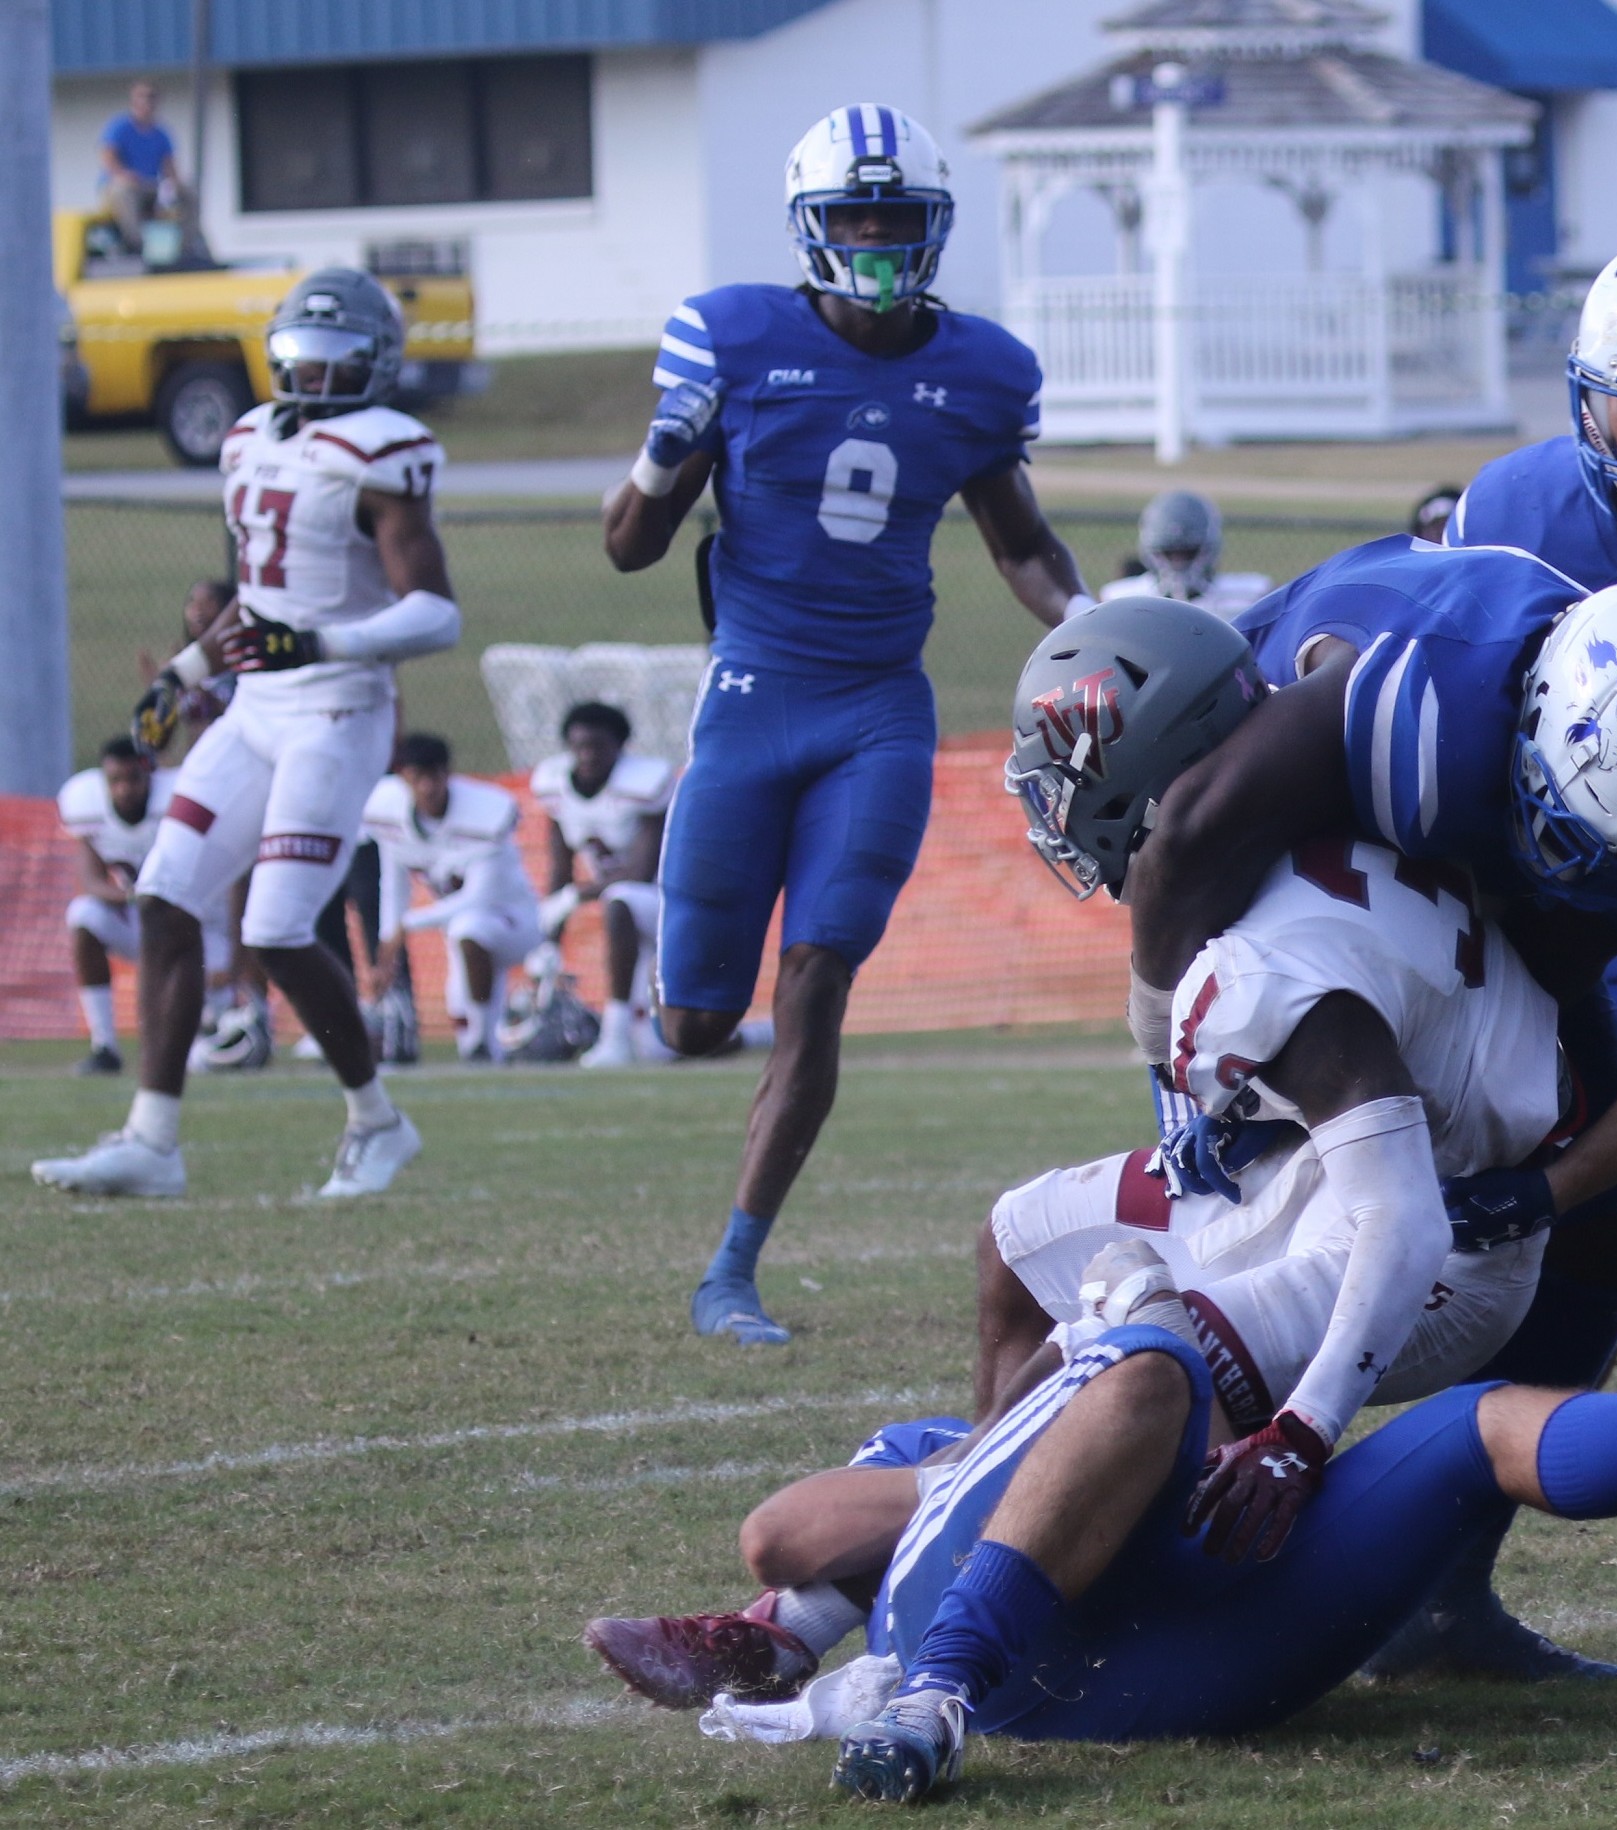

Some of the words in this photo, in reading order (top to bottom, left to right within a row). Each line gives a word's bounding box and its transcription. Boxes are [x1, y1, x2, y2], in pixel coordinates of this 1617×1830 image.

[767, 368, 815, 385] CIAA
[404, 460, 434, 499] 17
[232, 485, 296, 588] 17
